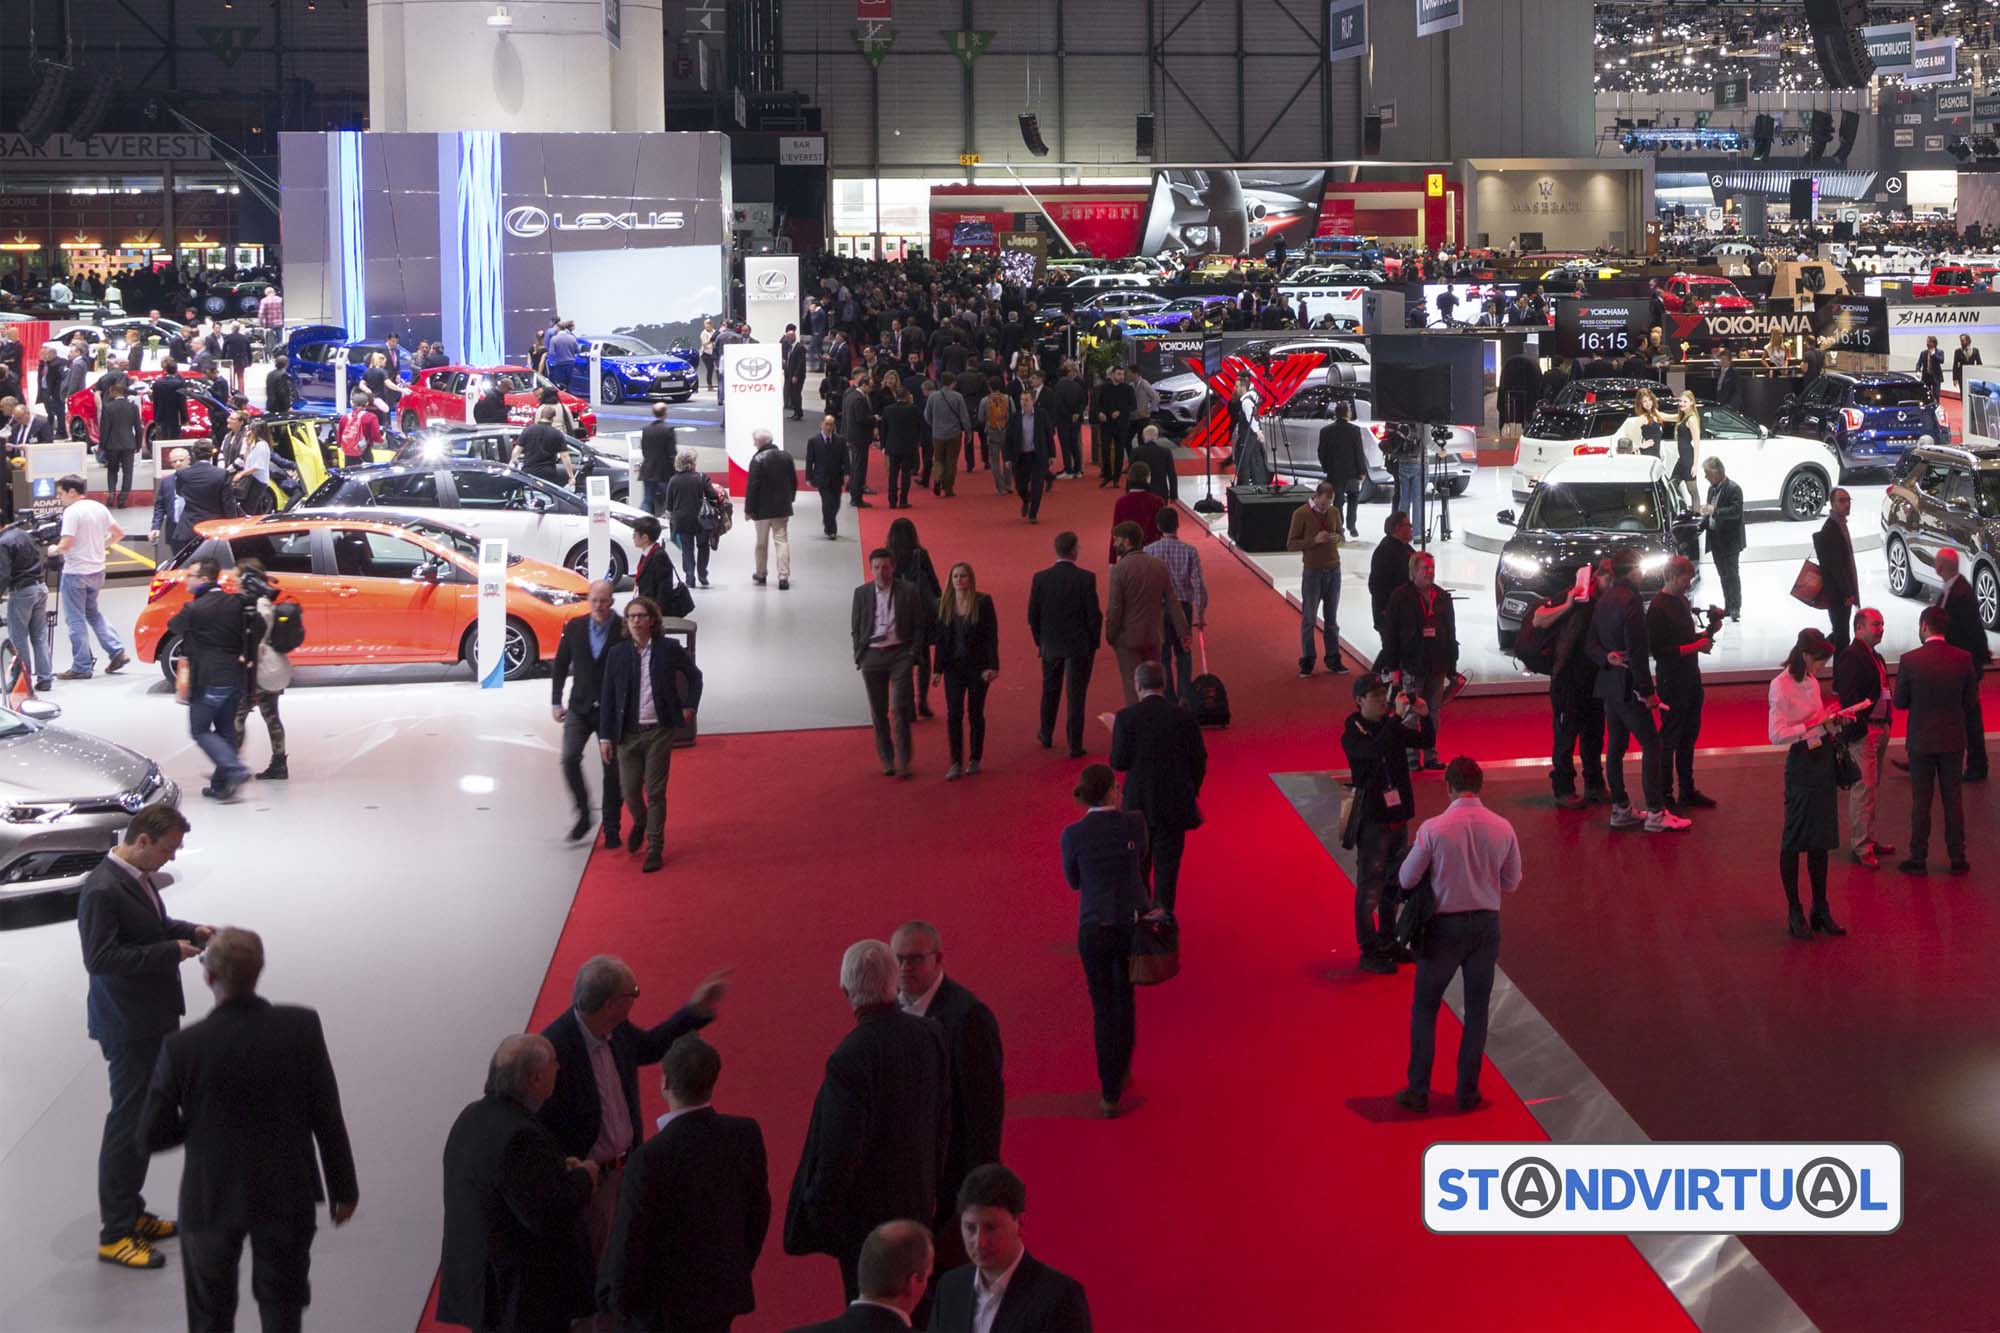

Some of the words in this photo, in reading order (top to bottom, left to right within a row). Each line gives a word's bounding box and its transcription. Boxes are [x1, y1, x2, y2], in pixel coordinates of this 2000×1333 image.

[1341, 15, 1354, 40] RUF
[1914, 58, 1929, 69] ODGE
[1939, 95, 1969, 109] GASMOBIL
[961, 155, 980, 164] 514
[553, 212, 685, 231] LEXUS
[1007, 234, 1038, 247] Jeep
[1589, 308, 1629, 316] YOKOHAMA
[1913, 311, 1980, 324] HAMANN
[1704, 315, 1813, 336] YOKOHAMA
[1578, 332, 1628, 350] 16:15
[1833, 327, 1872, 347] 16:15
[1158, 341, 1204, 351] YOKOHAM
[731, 383, 776, 393] TOYOTA
[33, 500, 62, 508] ADAPT
